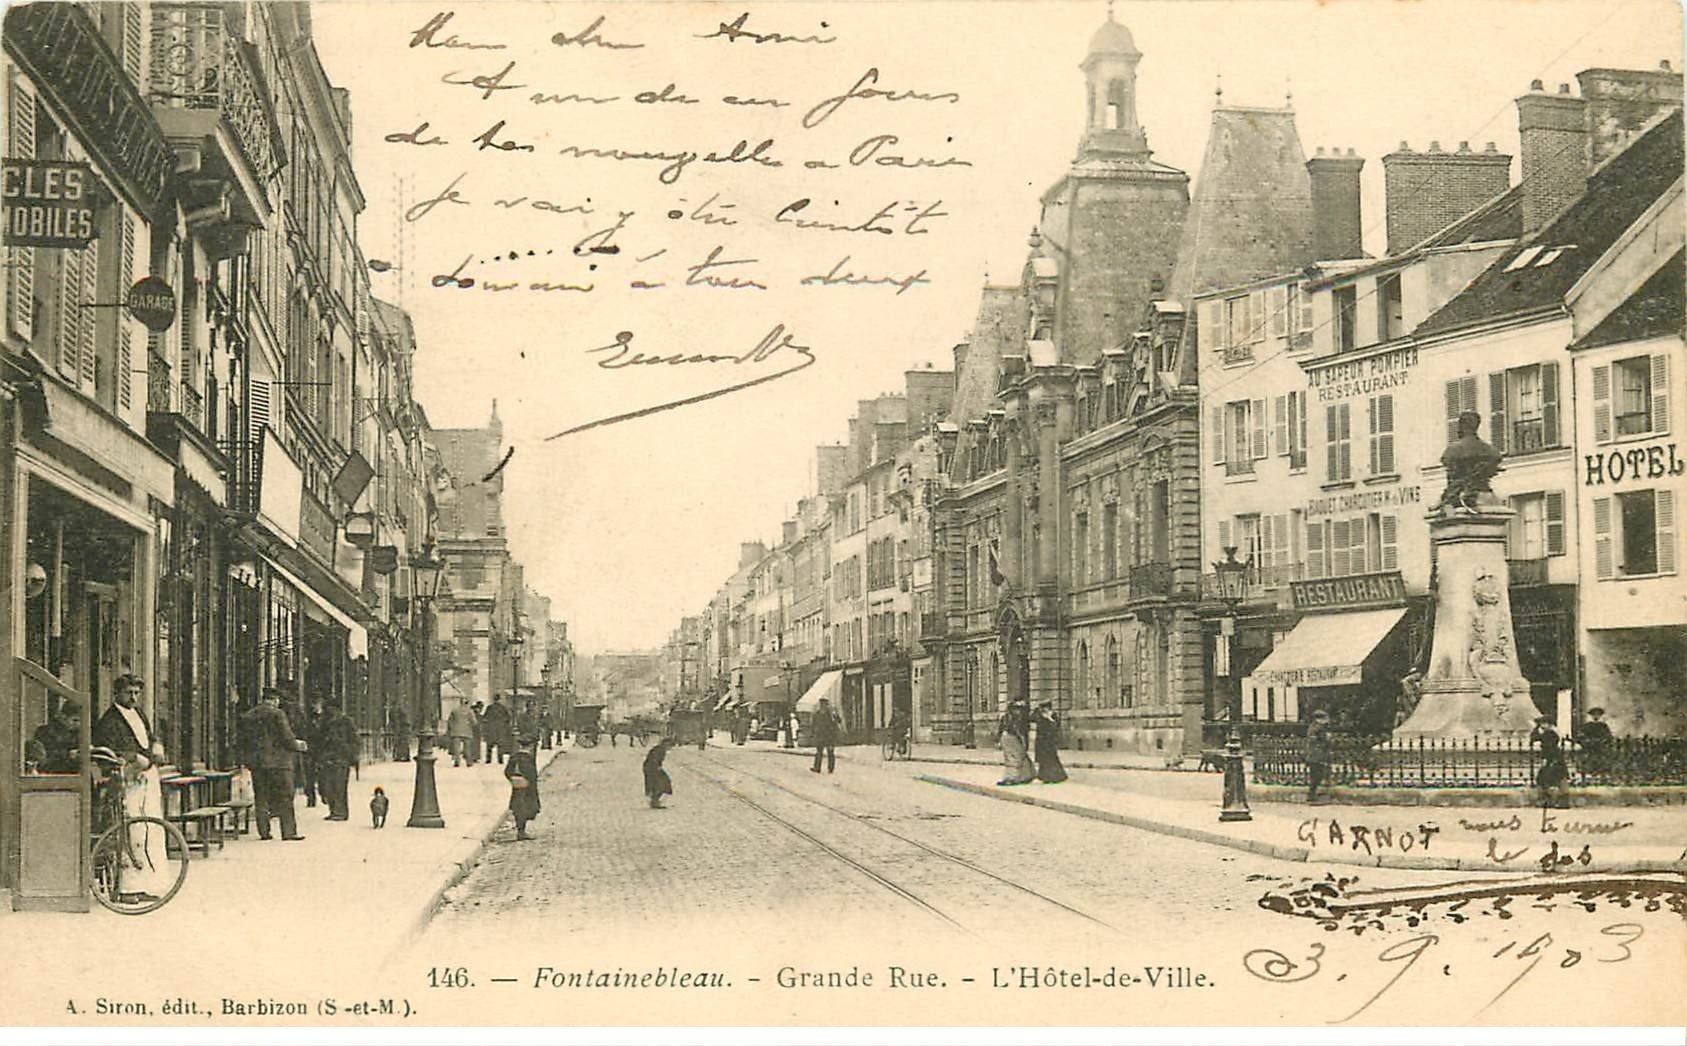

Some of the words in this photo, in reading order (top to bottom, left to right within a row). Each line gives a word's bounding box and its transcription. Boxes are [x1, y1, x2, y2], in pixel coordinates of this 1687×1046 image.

[2, 166, 83, 200] CLES
[129, 293, 175, 312] GARAGE
[1370, 348, 1419, 376] POMPIER
[1318, 370, 1409, 402] RESTAURANT
[1295, 576, 1399, 606] RESTAURANT
